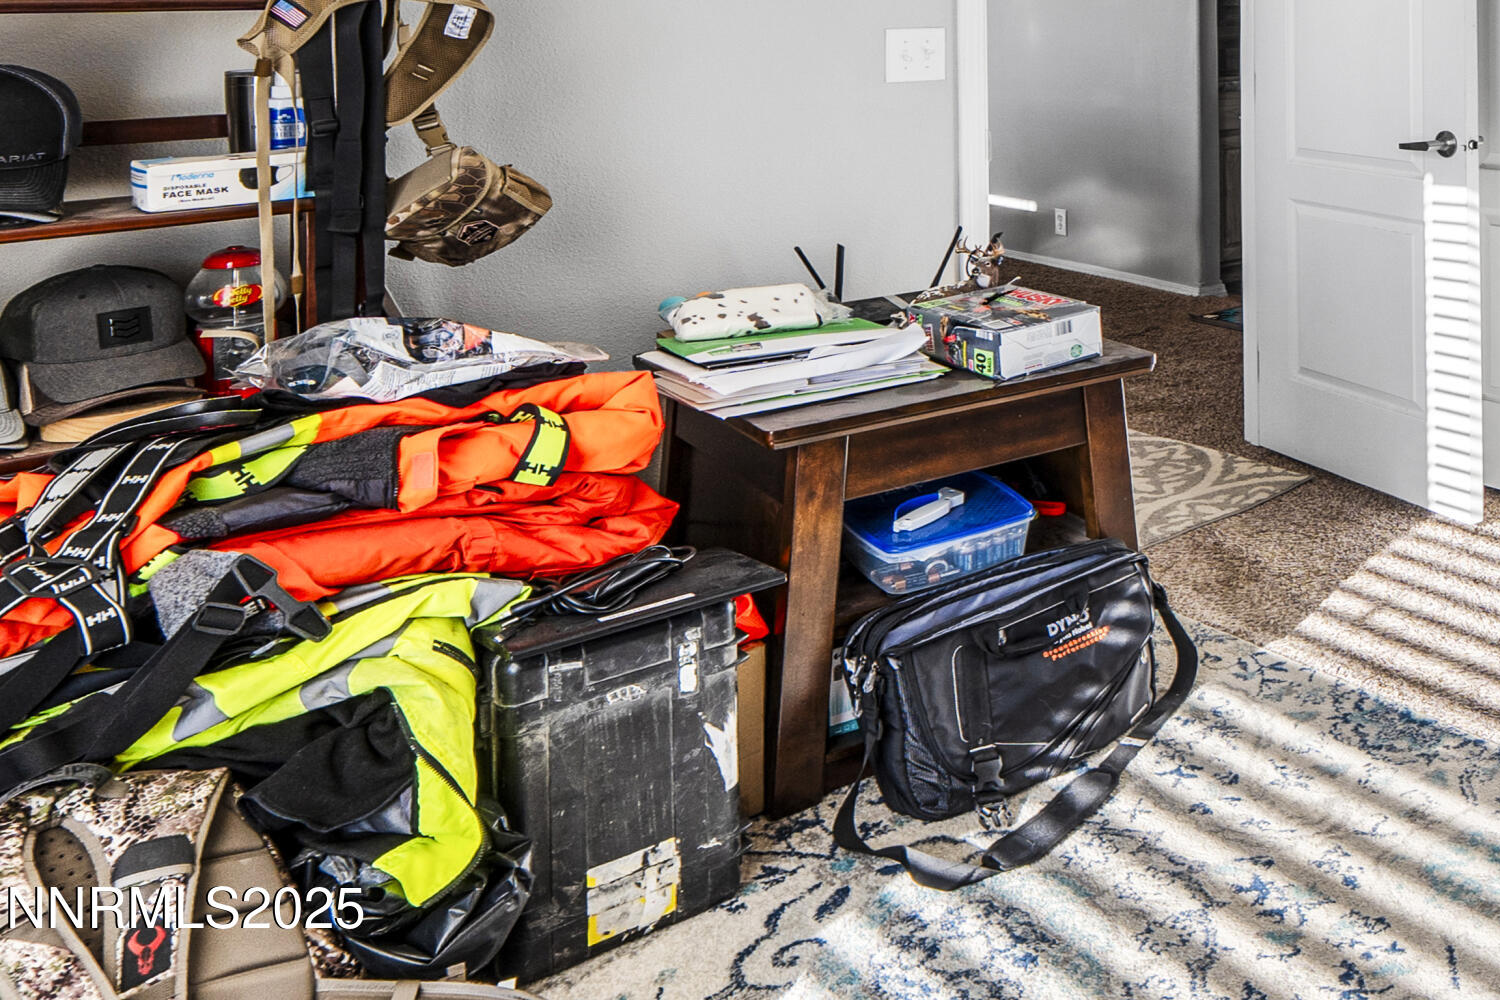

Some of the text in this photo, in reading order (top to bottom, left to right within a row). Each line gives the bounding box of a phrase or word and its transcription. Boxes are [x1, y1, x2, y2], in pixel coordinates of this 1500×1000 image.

[162, 186, 229, 199] FACE MASK
[163, 182, 207, 191] DISPOSABLE
[974, 352, 987, 373] 40
[121, 473, 150, 486] HH
[64, 545, 91, 558] HH
[86, 606, 117, 628] HH
